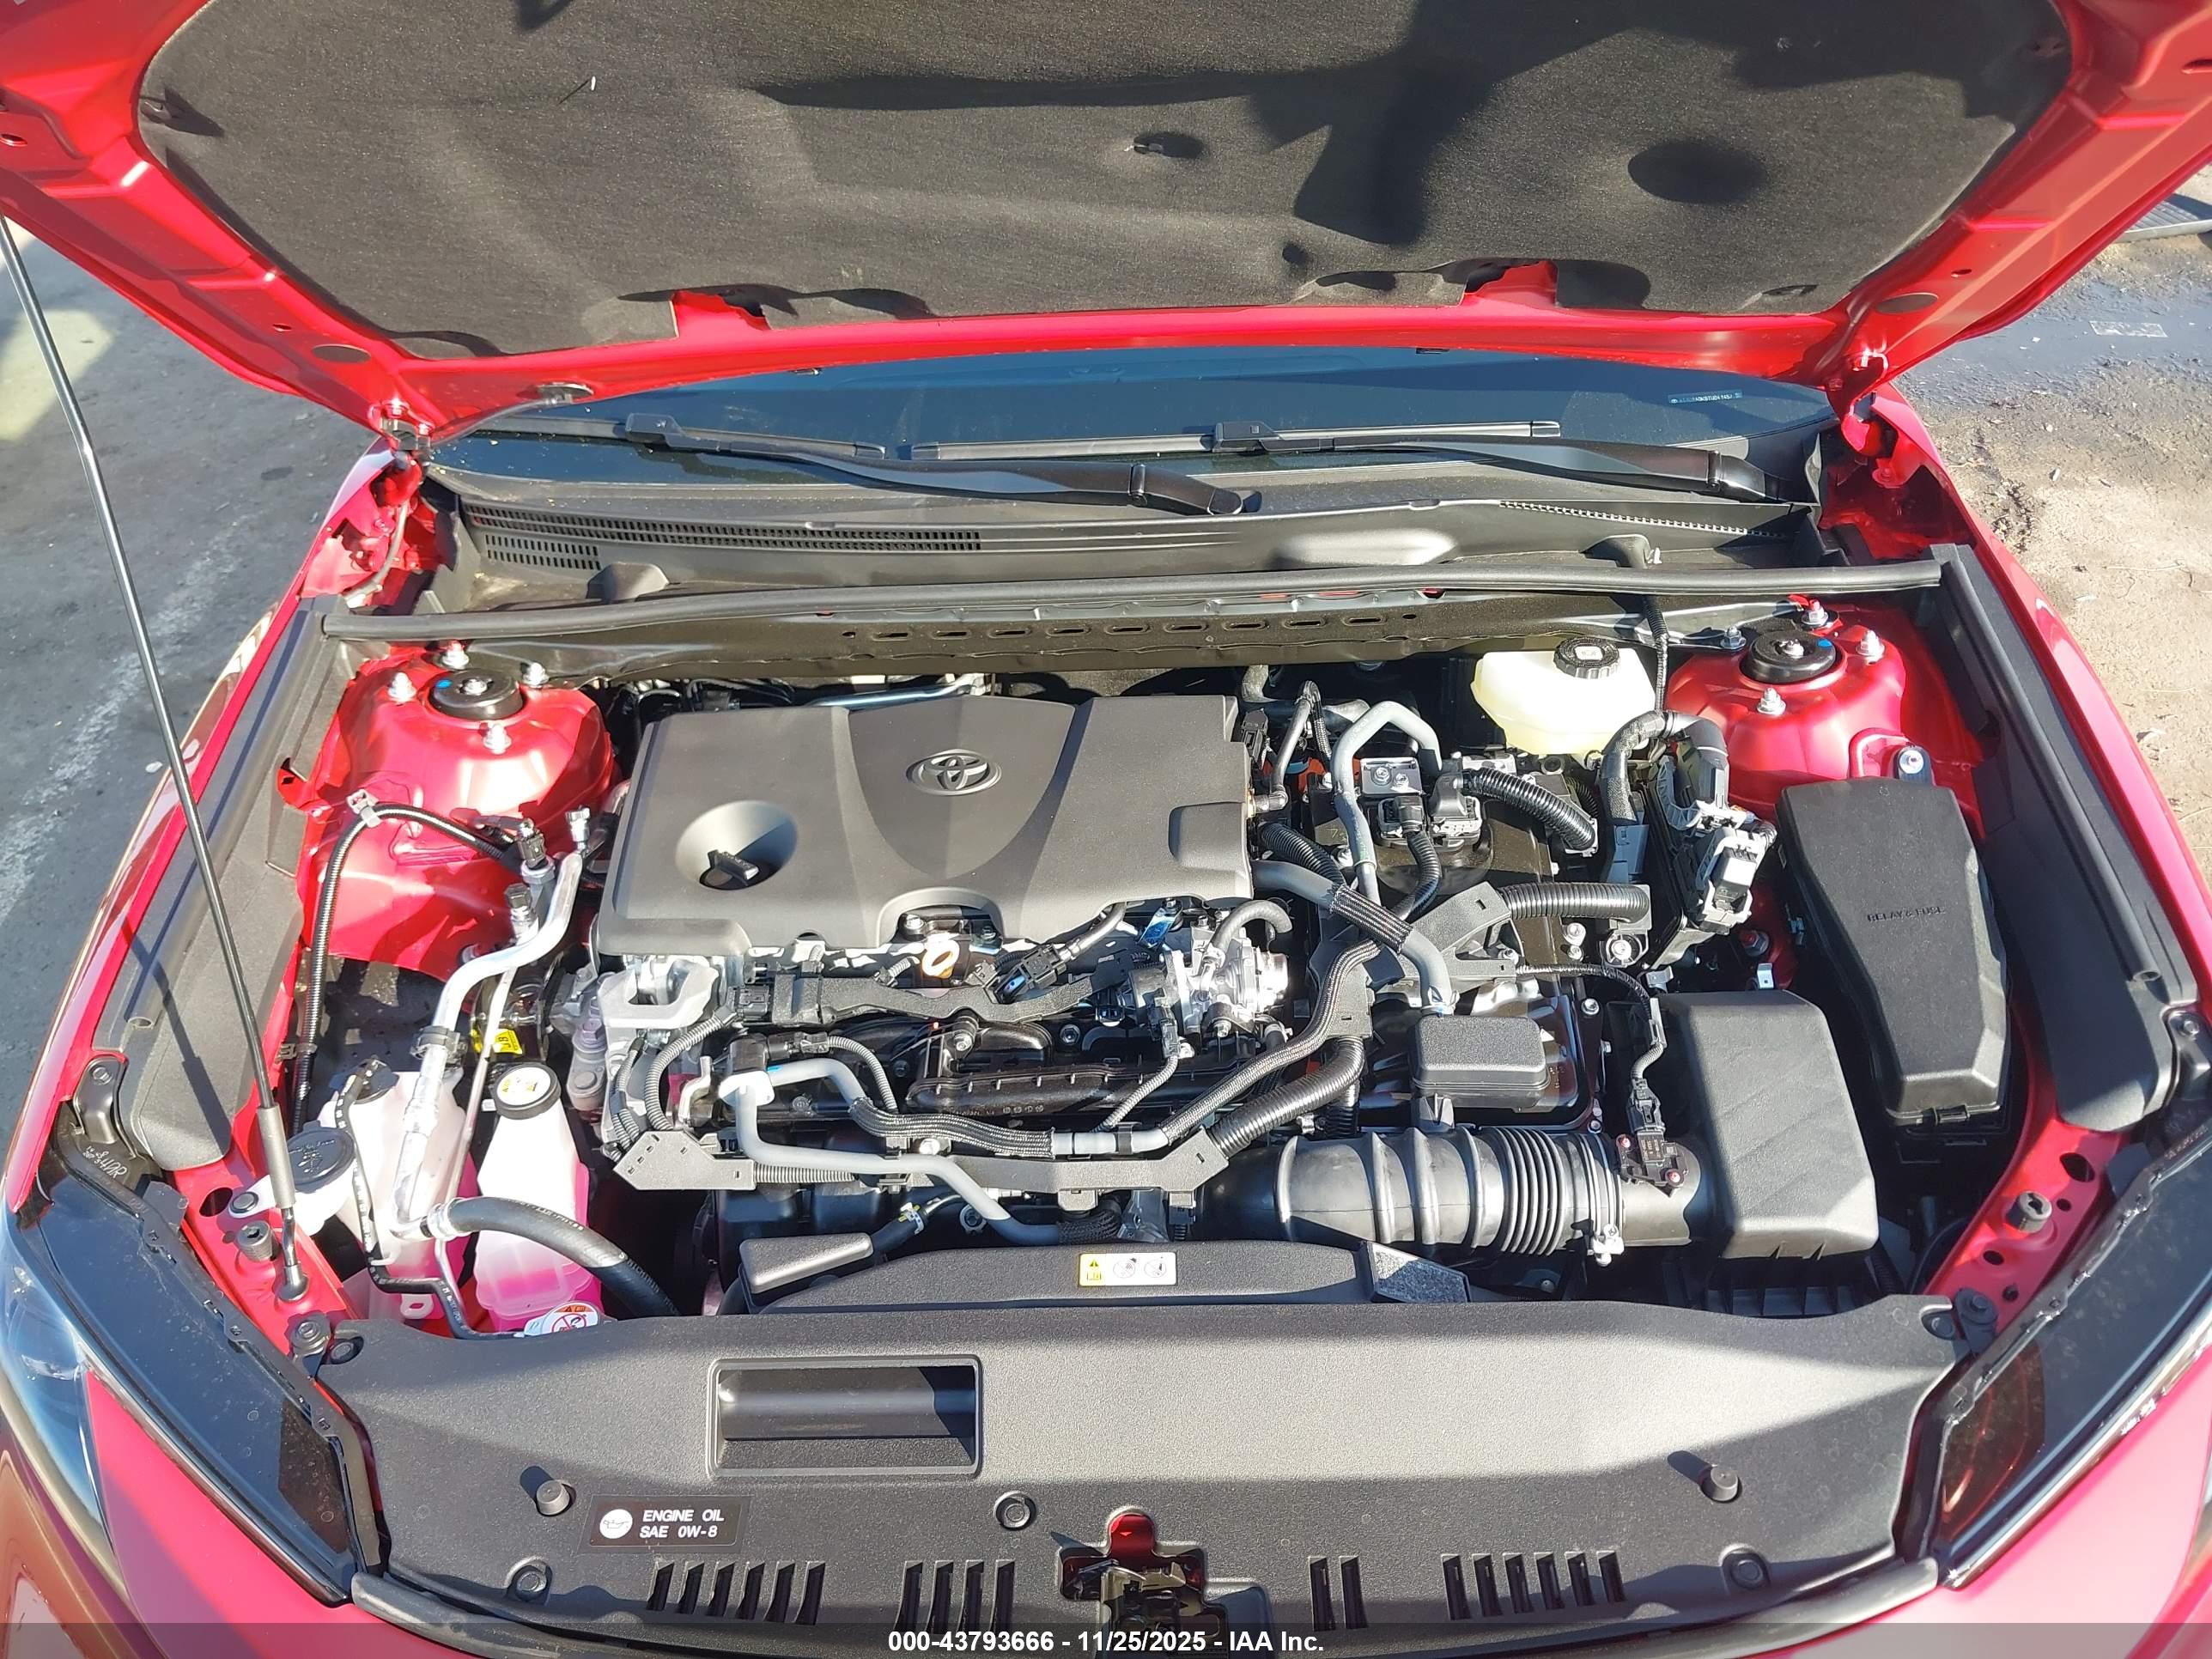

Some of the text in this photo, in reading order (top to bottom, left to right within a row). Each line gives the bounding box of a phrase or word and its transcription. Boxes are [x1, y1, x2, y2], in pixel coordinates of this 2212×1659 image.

[1867, 911, 1903, 921] RELAY
[1915, 906, 1947, 916] FUSE
[642, 1509, 725, 1522] ENGINE OIL
[639, 1525, 718, 1539] SAE 0W-8
